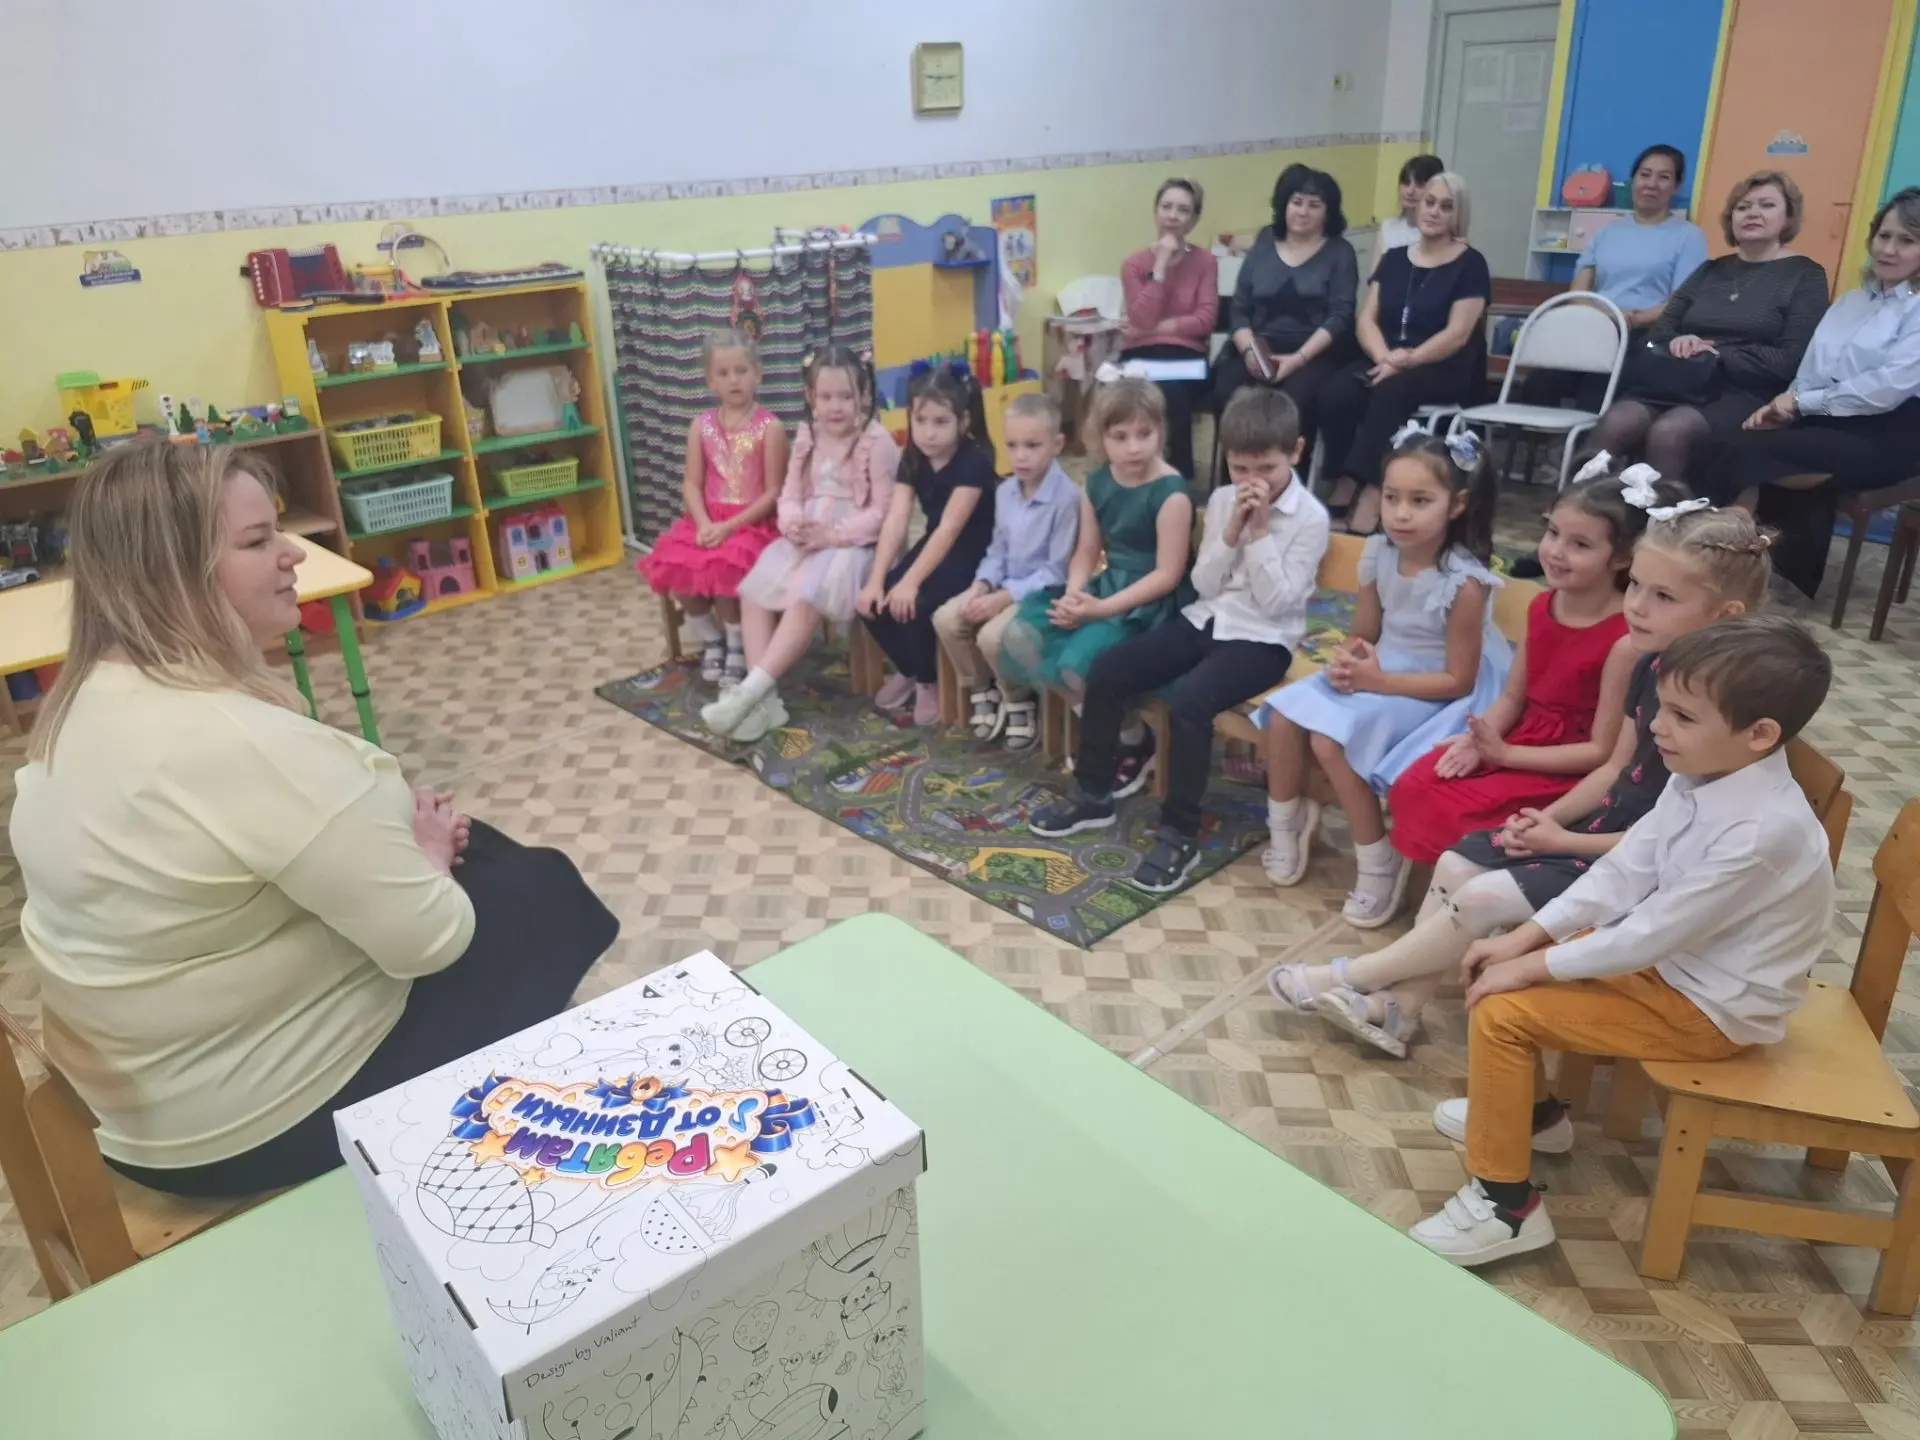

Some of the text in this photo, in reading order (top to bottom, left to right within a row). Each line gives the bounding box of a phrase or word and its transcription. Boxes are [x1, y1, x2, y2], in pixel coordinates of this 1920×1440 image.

[513, 1093, 722, 1139] от Дзиньки
[505, 1127, 710, 1186] Ребятам
[523, 1315, 641, 1388] Design by Valiant
